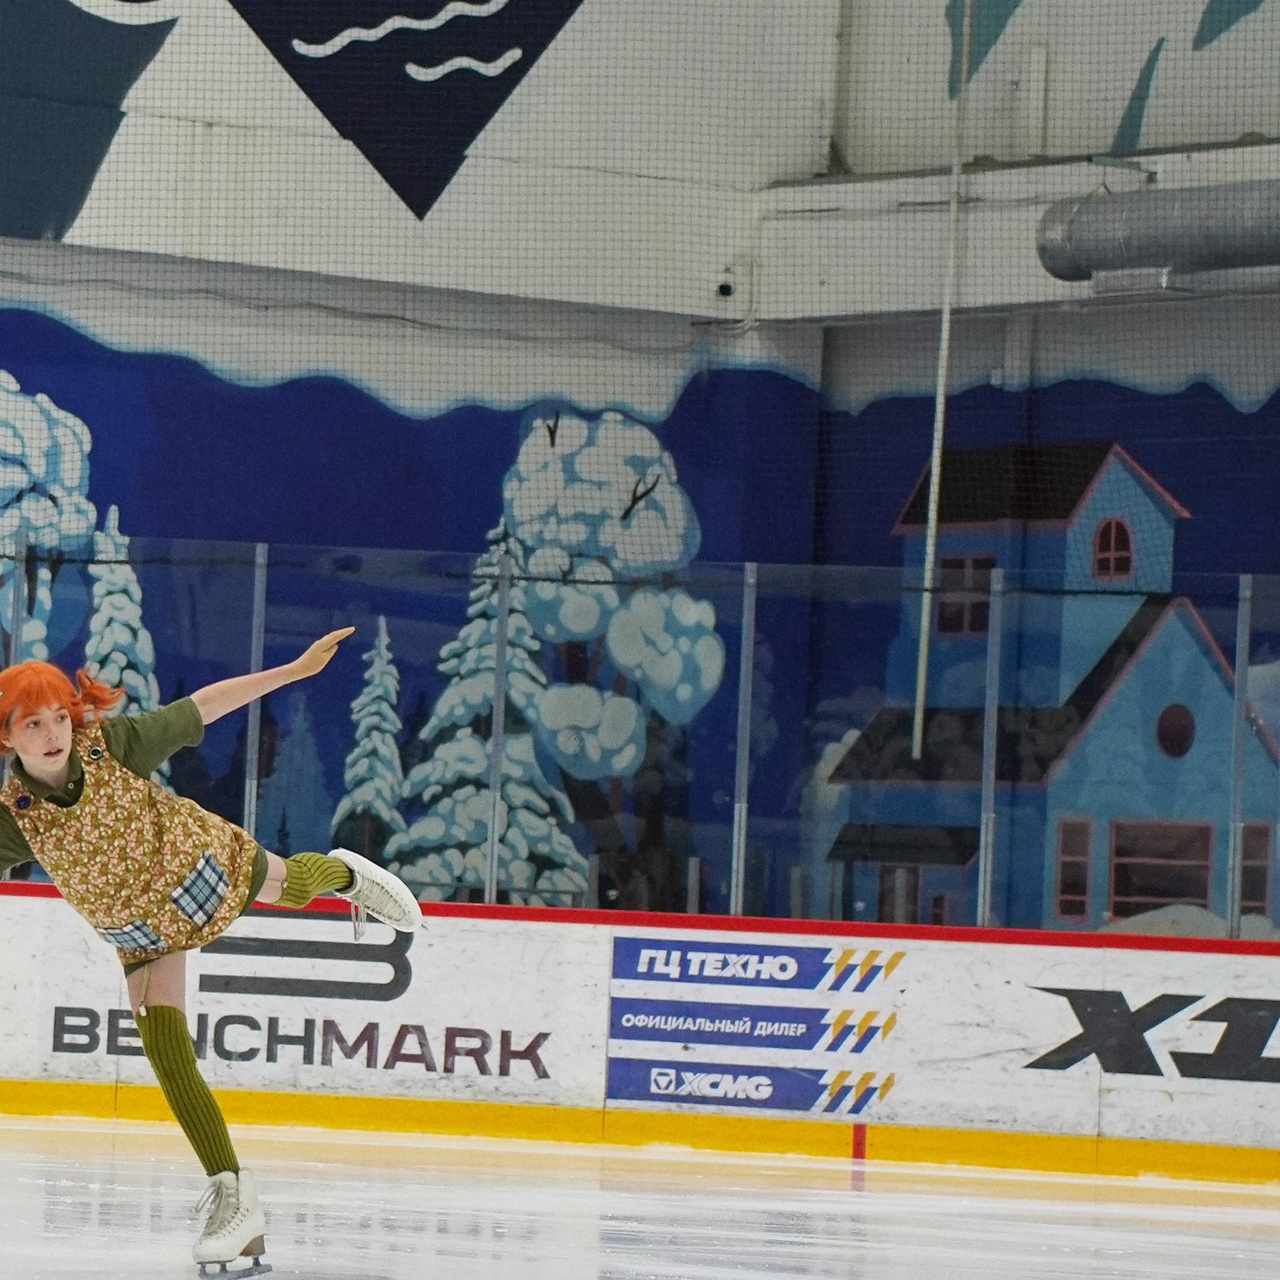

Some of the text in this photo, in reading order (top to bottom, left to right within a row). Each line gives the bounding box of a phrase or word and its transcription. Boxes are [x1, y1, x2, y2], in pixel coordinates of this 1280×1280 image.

[637, 949, 798, 981] ГЦ ТЕХНО
[621, 1013, 807, 1037] ОФИЦИАЛЬНЫЙ ДИЛЕР
[675, 1071, 773, 1099] XCMG
